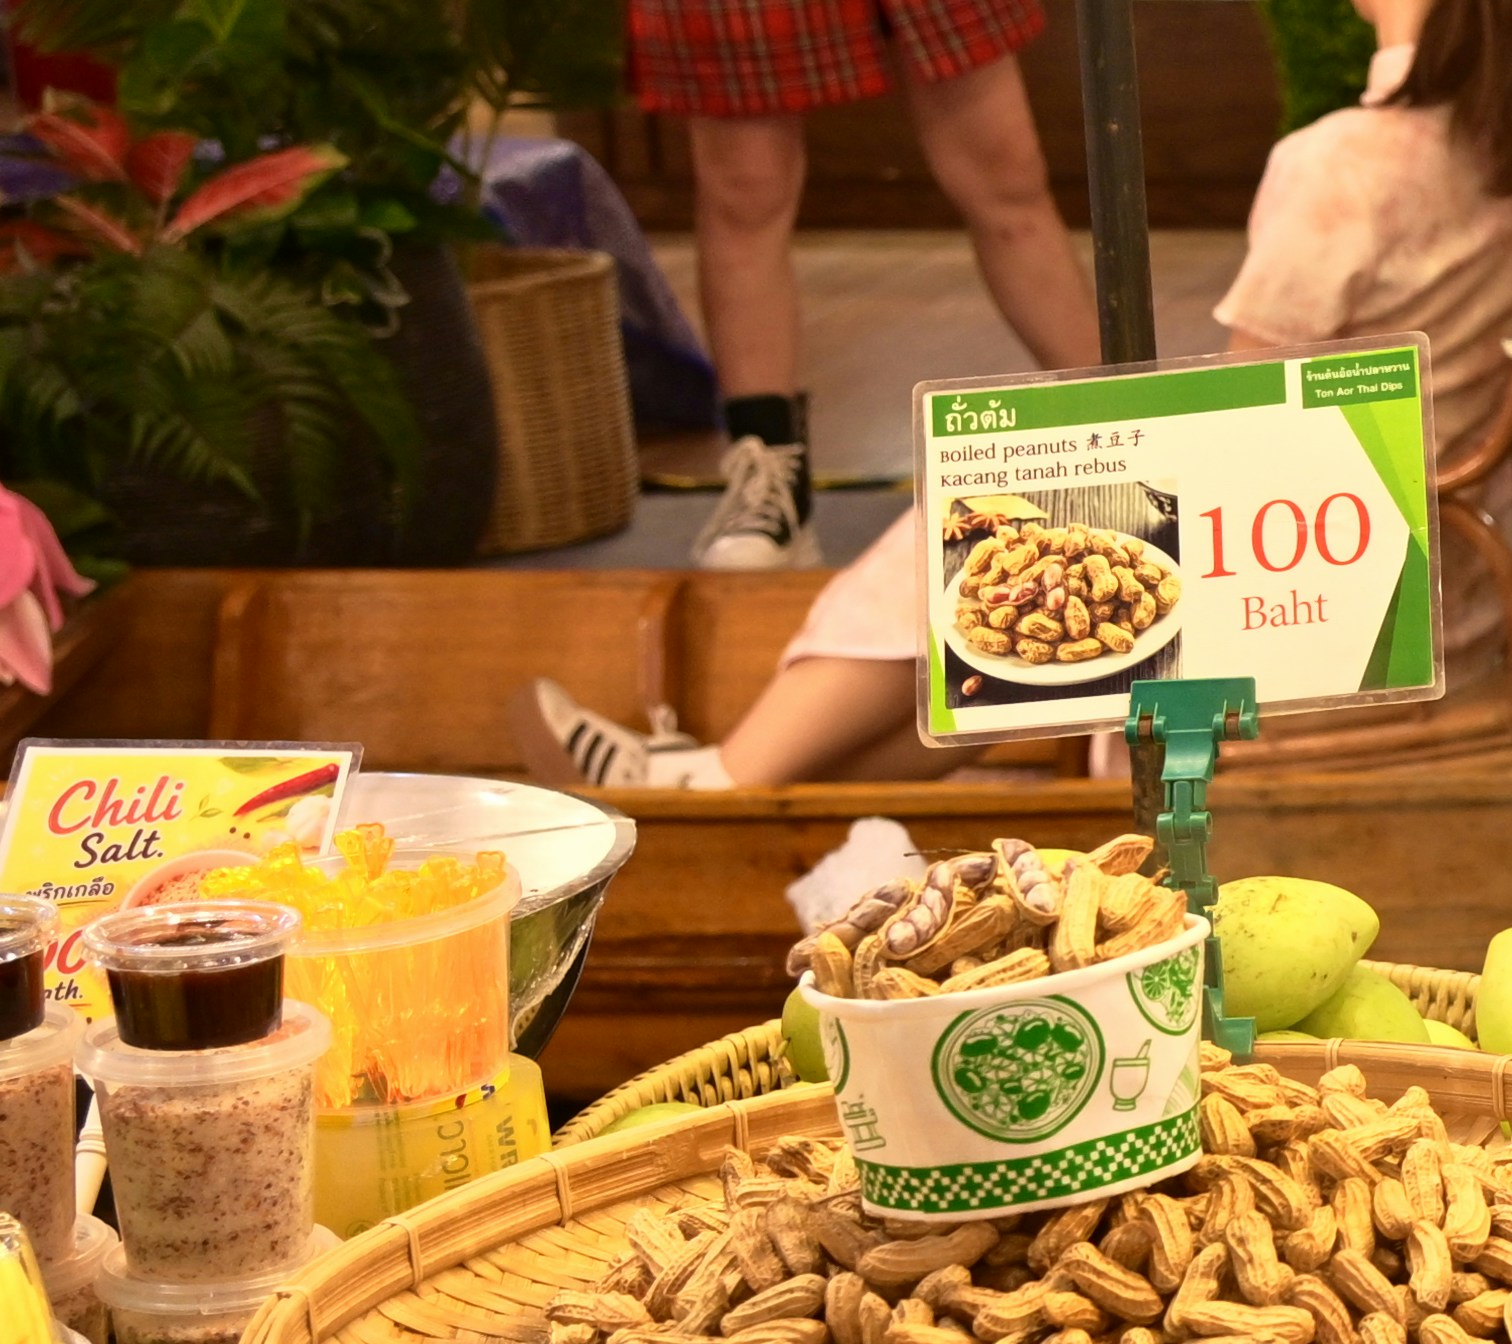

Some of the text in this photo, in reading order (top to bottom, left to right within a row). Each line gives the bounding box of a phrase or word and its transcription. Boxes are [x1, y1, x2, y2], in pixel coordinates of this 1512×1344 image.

[1356, 383, 1378, 394] Thai
[1381, 382, 1403, 393] Dips
[945, 395, 1017, 432] ถั่วต้ม
[940, 442, 996, 463] Boiled
[1003, 439, 1077, 463] peanuts
[940, 457, 1127, 488] Kacang tanah rebus
[1199, 492, 1371, 579] 100
[1241, 589, 1329, 631] Baht
[48, 775, 185, 835] Chili
[74, 828, 164, 869] Salt.
